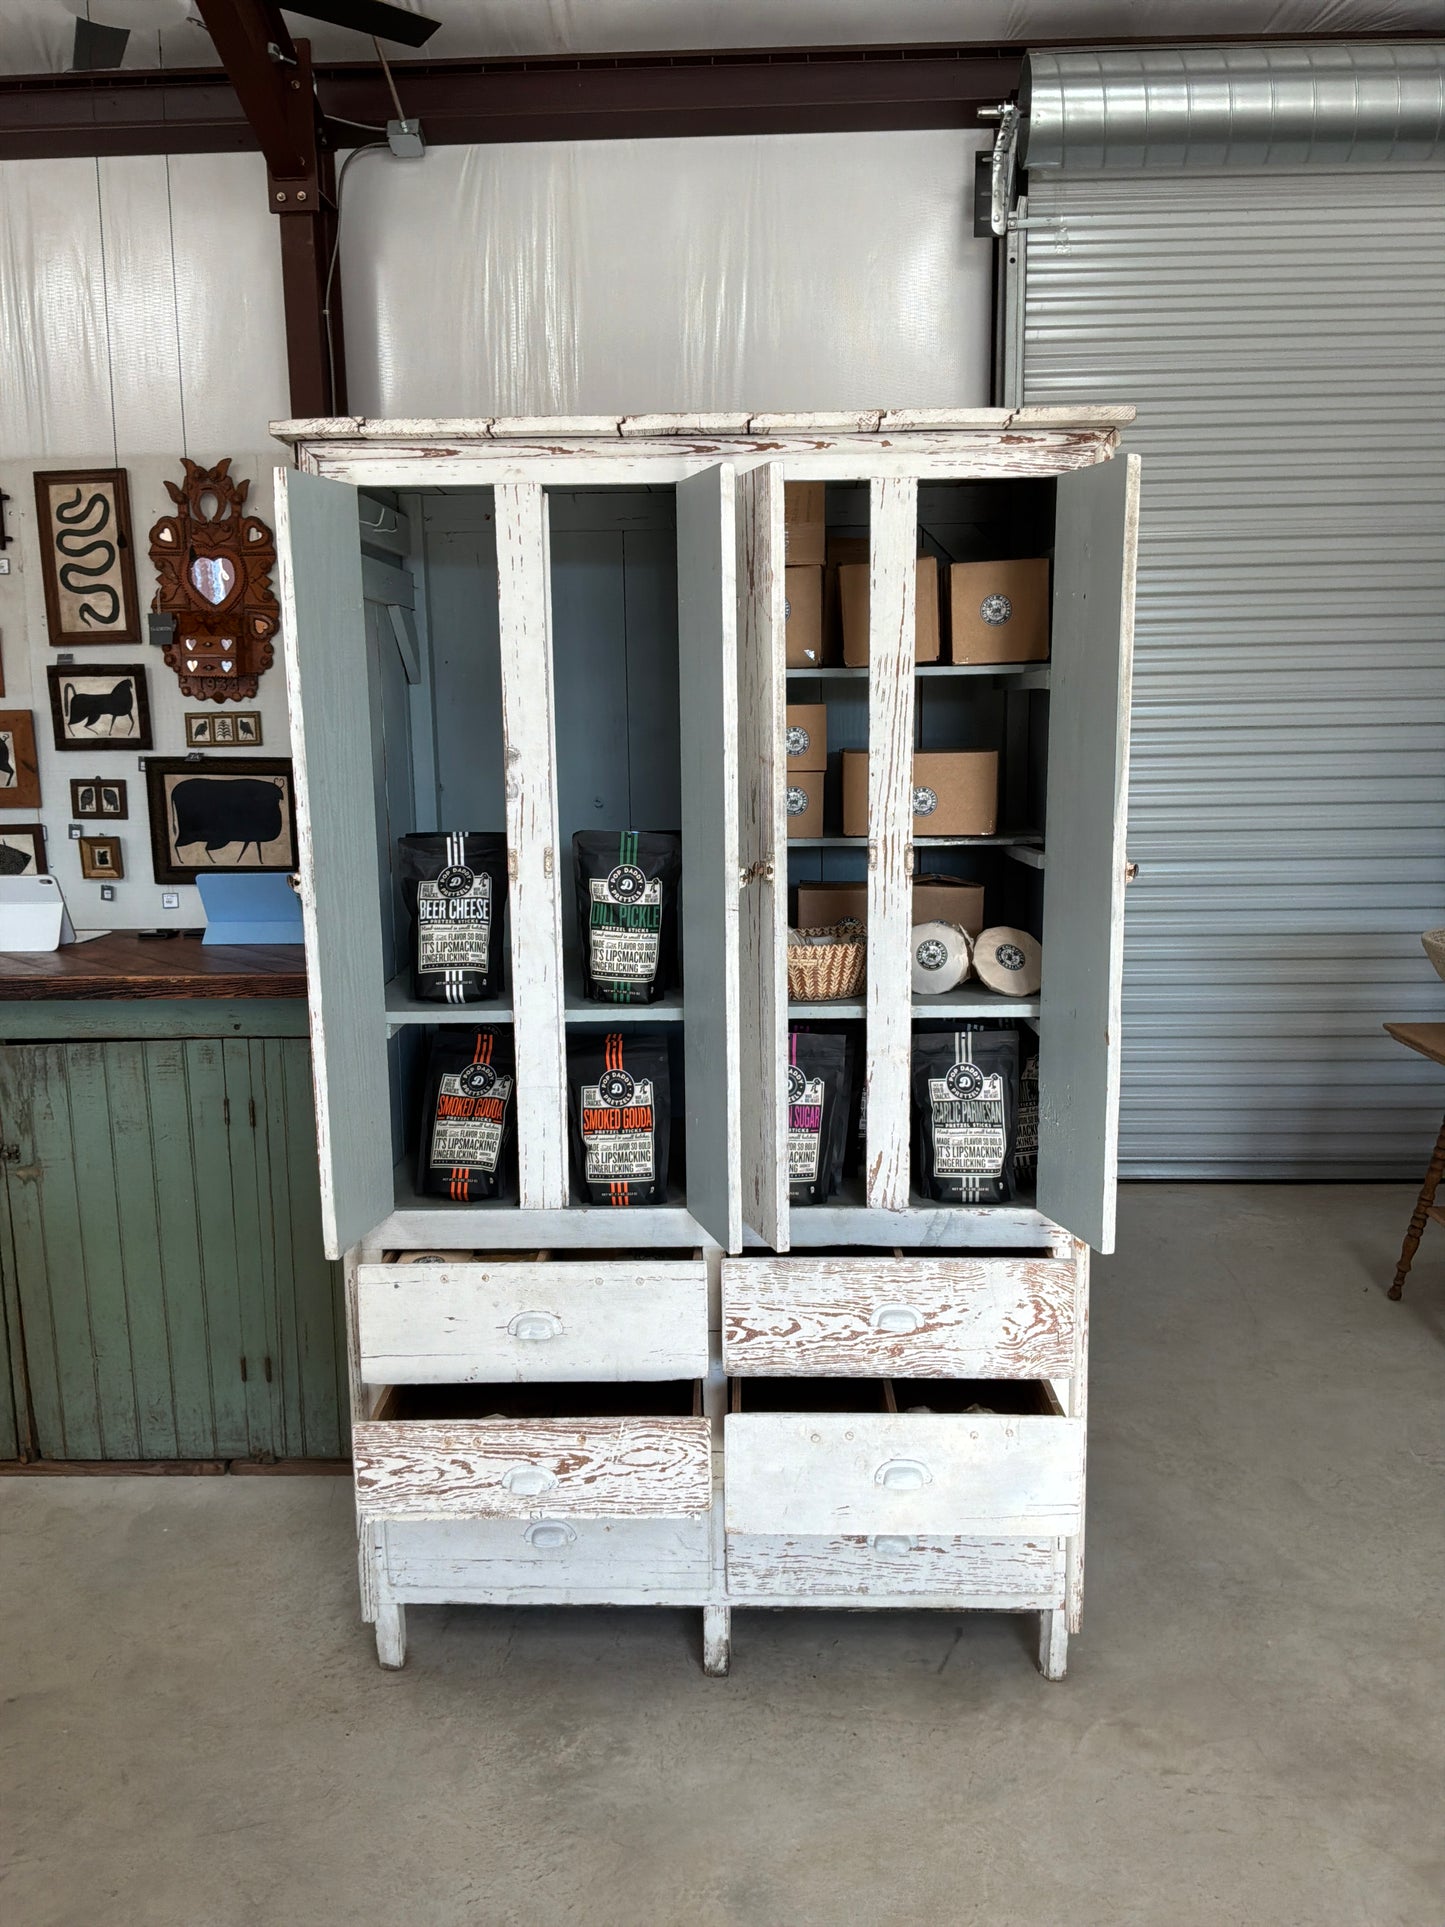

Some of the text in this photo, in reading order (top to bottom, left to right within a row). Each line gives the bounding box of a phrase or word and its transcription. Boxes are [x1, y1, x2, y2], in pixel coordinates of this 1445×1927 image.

[440, 867, 472, 883] POP DADDY
[611, 867, 643, 883] POP DADDY
[440, 885, 470, 897] PRETZELS
[611, 890, 642, 903] PRETZELS
[420, 898, 489, 919] BEER CHEESE
[592, 902, 660, 928] DILL PICKLE
[448, 933, 466, 941] FLAVOR
[475, 933, 487, 941] BOLD
[422, 941, 486, 954] IT'S LIPSMACKING
[618, 942, 636, 950] FLAVOR
[645, 943, 656, 951] BOLD
[422, 953, 469, 963] FINGERLICKING
[593, 948, 655, 963] IT'S LIPSMACKING
[463, 1065, 494, 1080] POP DADDY
[949, 1065, 981, 1082] POP DADDY
[602, 1072, 632, 1088] POP DADDY
[462, 1084, 490, 1096] PRETZELS
[951, 1087, 980, 1099] PRETZELS
[603, 1093, 632, 1105] PRETZELS
[437, 1095, 504, 1120] SMOKED GOUDA
[933, 1101, 1001, 1123] GARLIC PARMESAN
[584, 1106, 652, 1130] SMOKED GOUDA
[794, 1105, 820, 1128] SUGAR
[460, 1130, 478, 1138] FLAVOR
[478, 1131, 485, 1139] SO
[434, 1138, 497, 1153] IT'S LIPSMACKING
[613, 1142, 630, 1151] FLAVOR
[631, 1142, 637, 1150] SO
[638, 1141, 651, 1150] BOLD
[804, 1142, 816, 1150] BOLD
[936, 1138, 950, 1146] MADE
[433, 1149, 478, 1160] FINGERLICKING
[601, 1150, 651, 1163] LIPSMACKING
[937, 1146, 1002, 1158] IT'S LIPSMACKING
[588, 1163, 634, 1173] FINGERLICKING
[937, 1159, 986, 1168] FINGERLICKING
